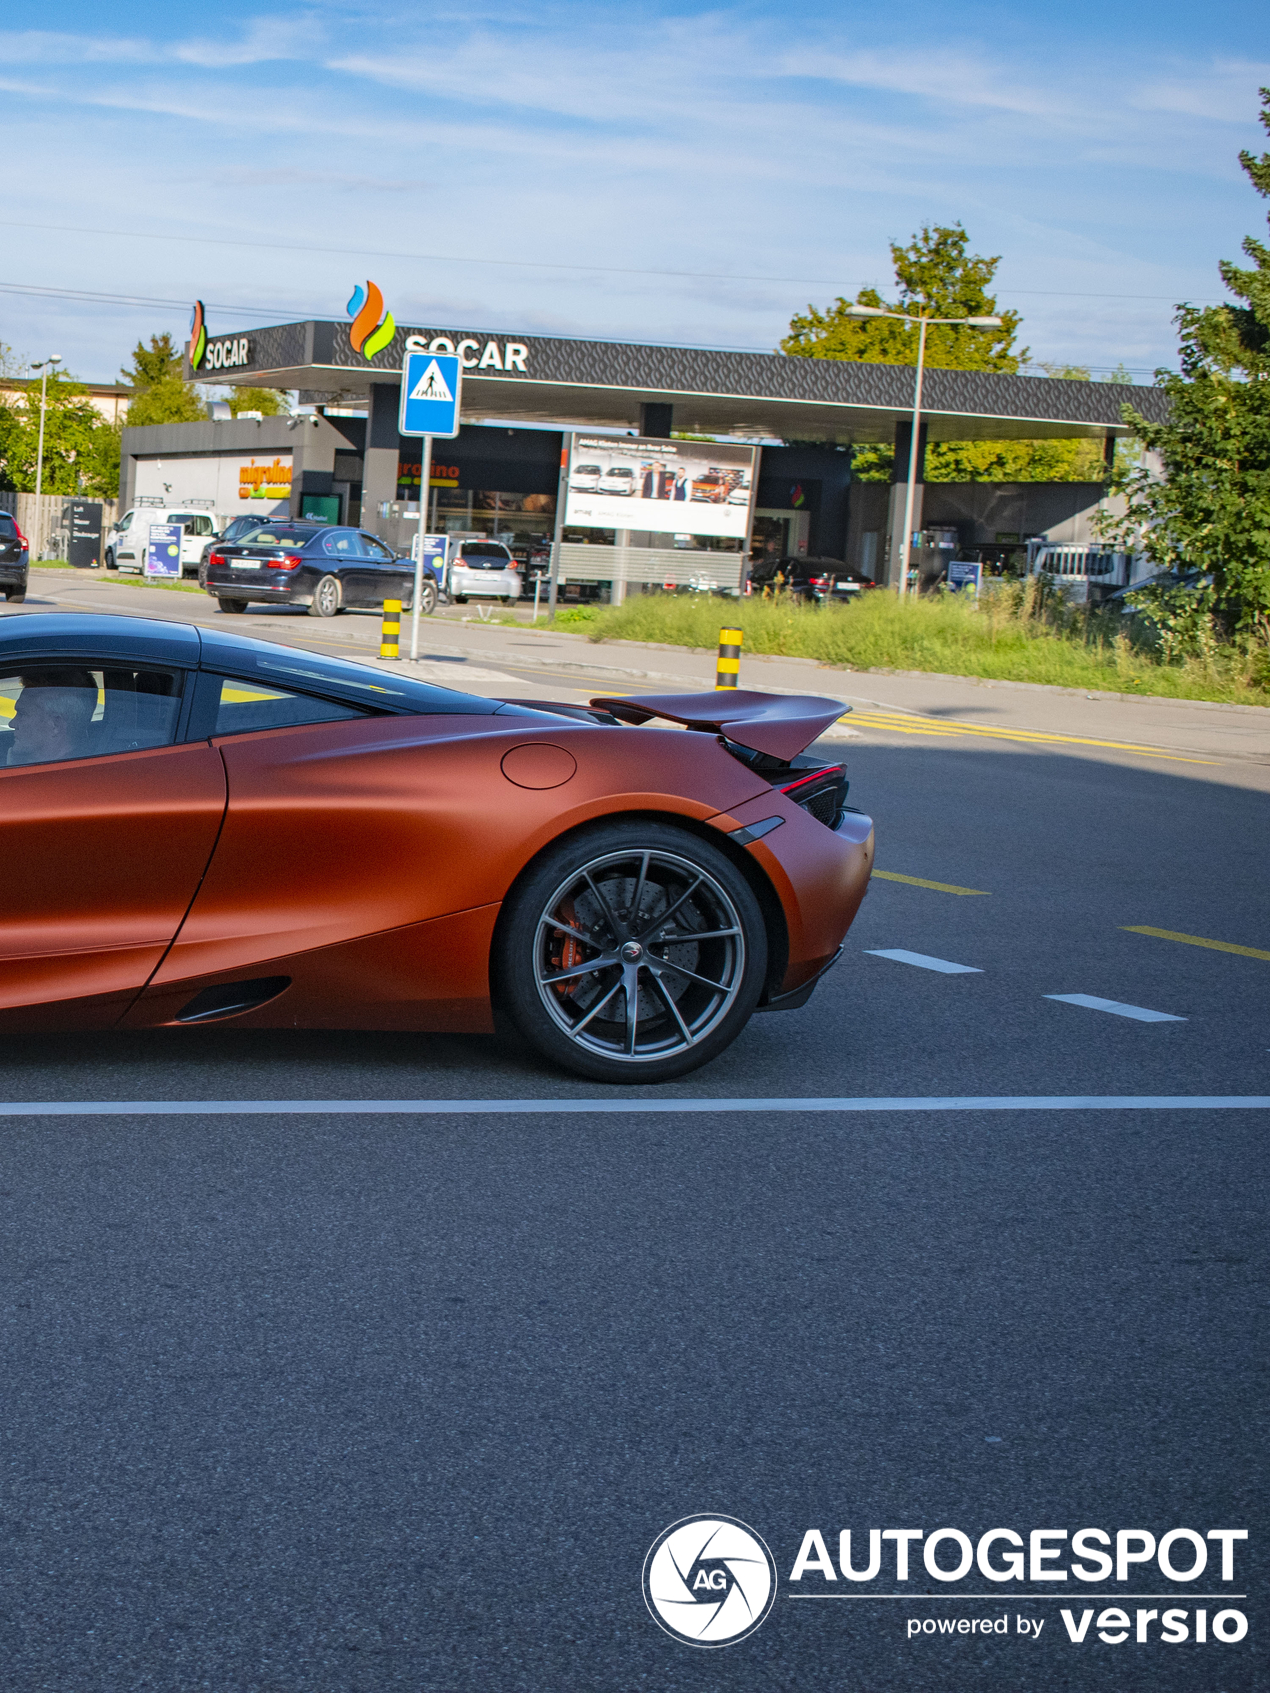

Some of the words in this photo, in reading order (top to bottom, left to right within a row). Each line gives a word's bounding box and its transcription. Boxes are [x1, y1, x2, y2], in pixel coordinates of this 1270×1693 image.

[205, 338, 249, 370] SOCAR
[404, 335, 529, 373] SOCAR
[239, 457, 293, 492] migrolino
